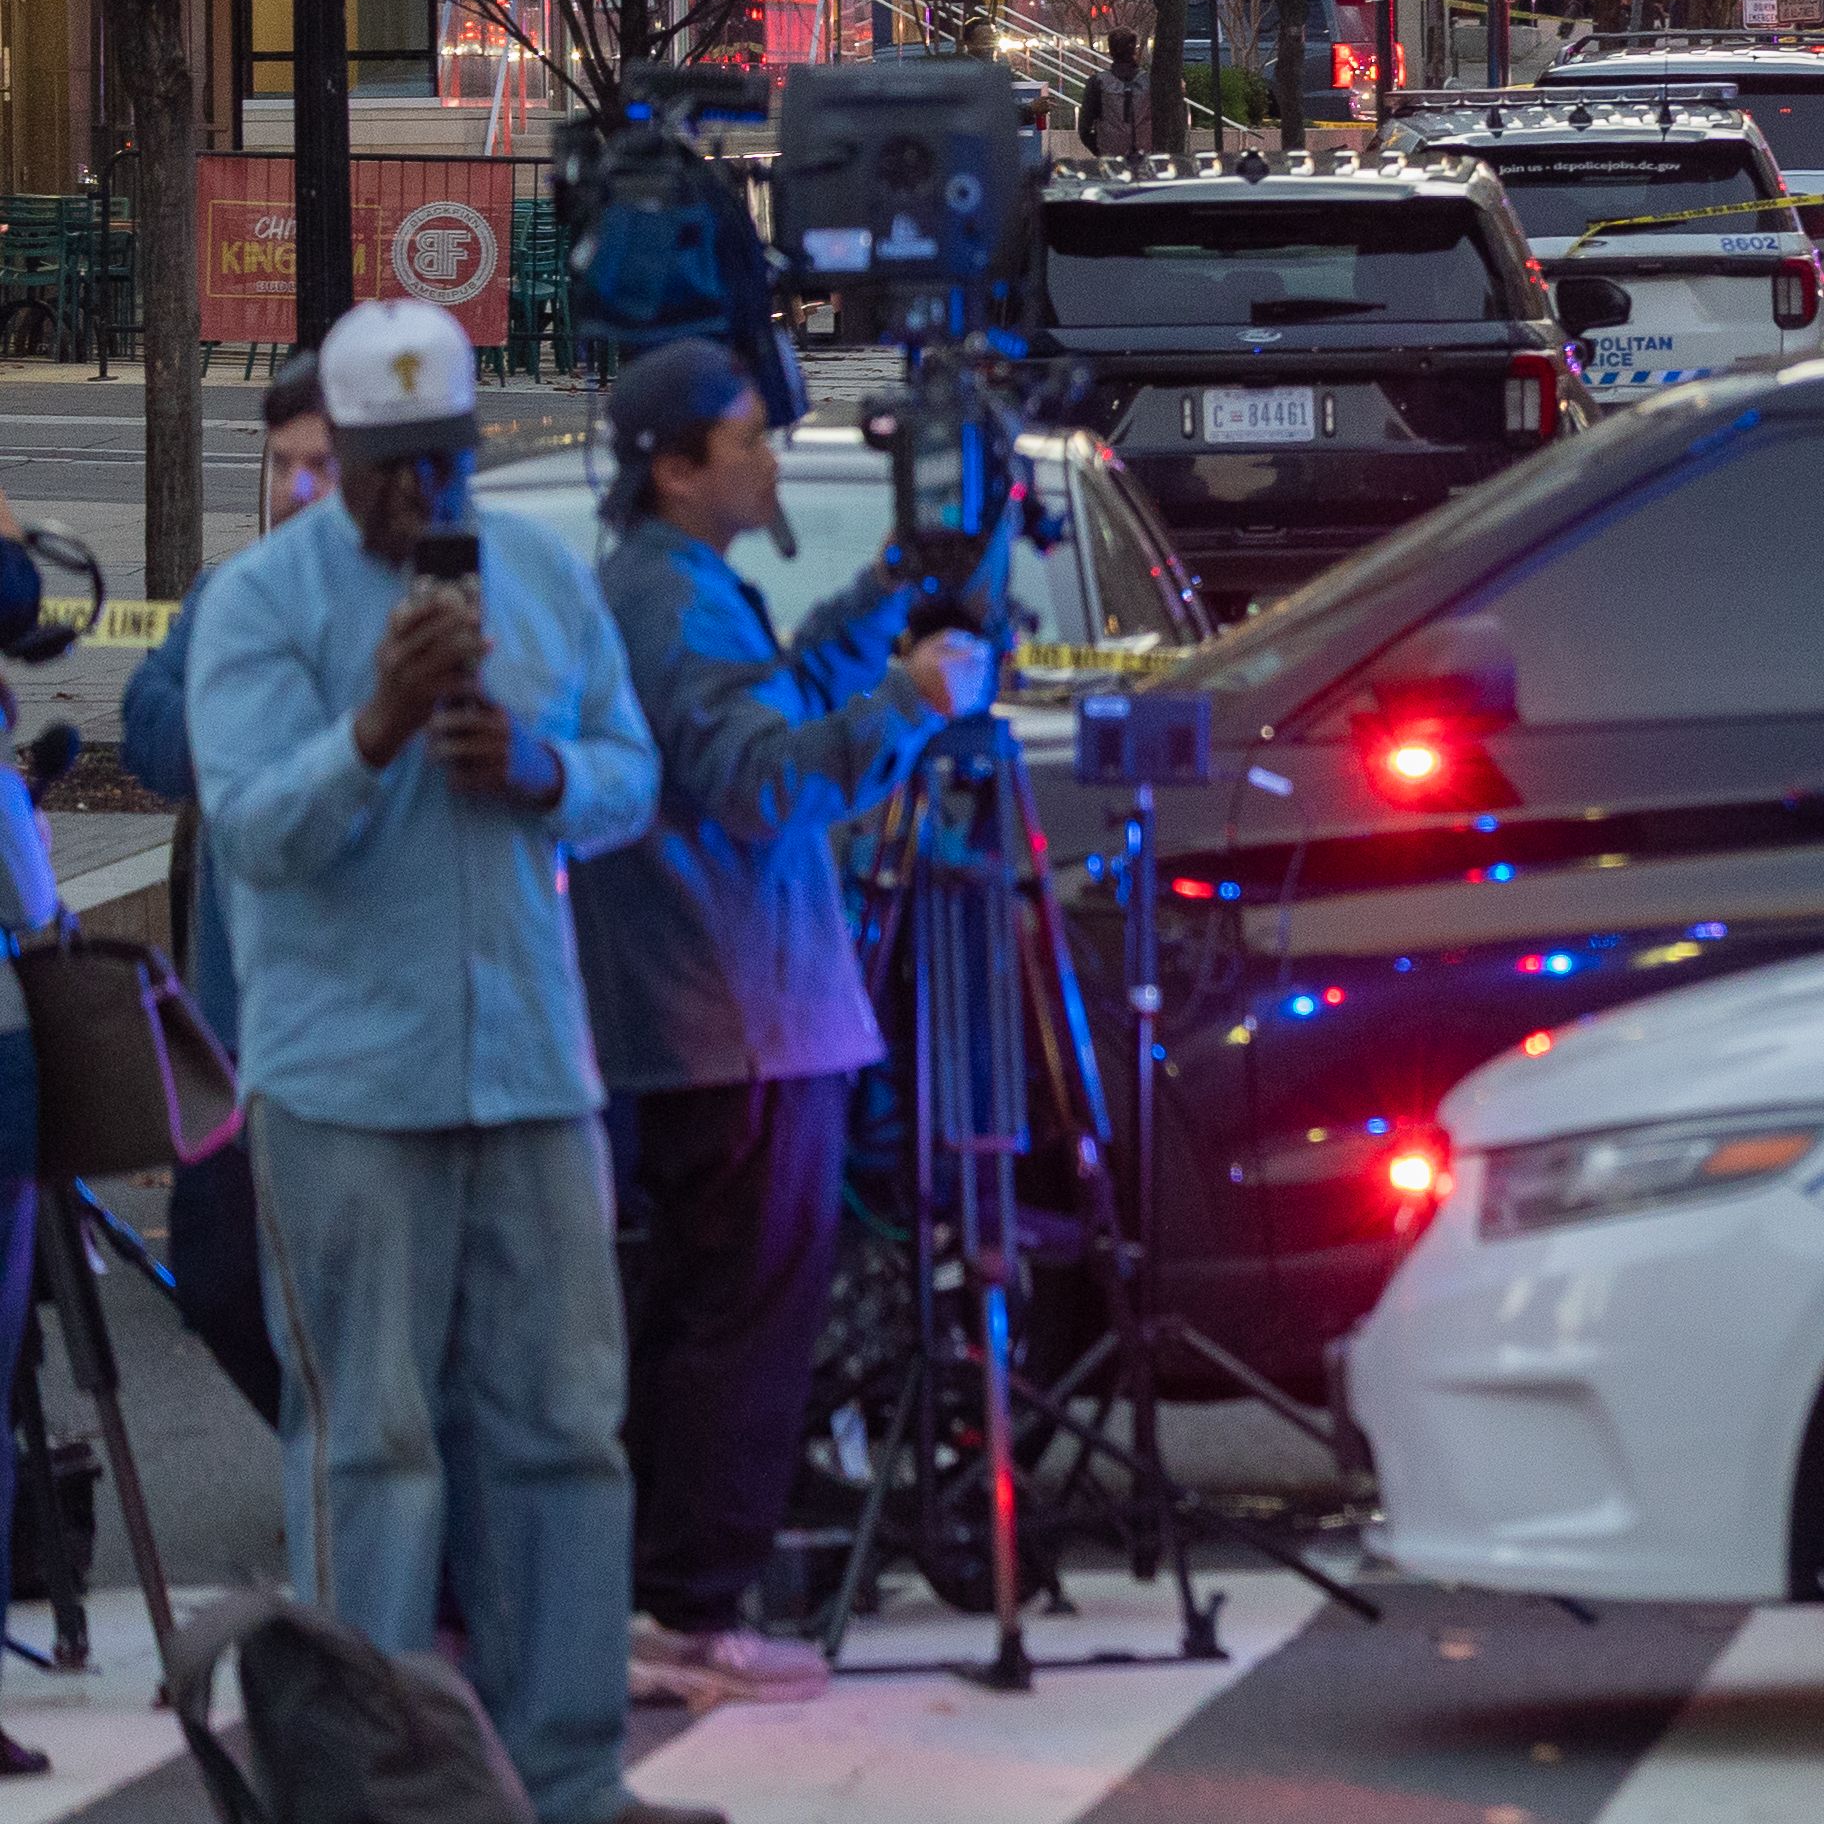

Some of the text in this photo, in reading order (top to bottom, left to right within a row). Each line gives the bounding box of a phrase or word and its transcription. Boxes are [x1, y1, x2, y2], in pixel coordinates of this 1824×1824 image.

[1553, 160, 1681, 173] dcpolicejobs.dc.gov
[406, 204, 482, 231] BLACKFINN
[1720, 236, 1779, 252] 8602
[409, 277, 478, 304] AMERIPUB
[108, 606, 156, 639] LINE
